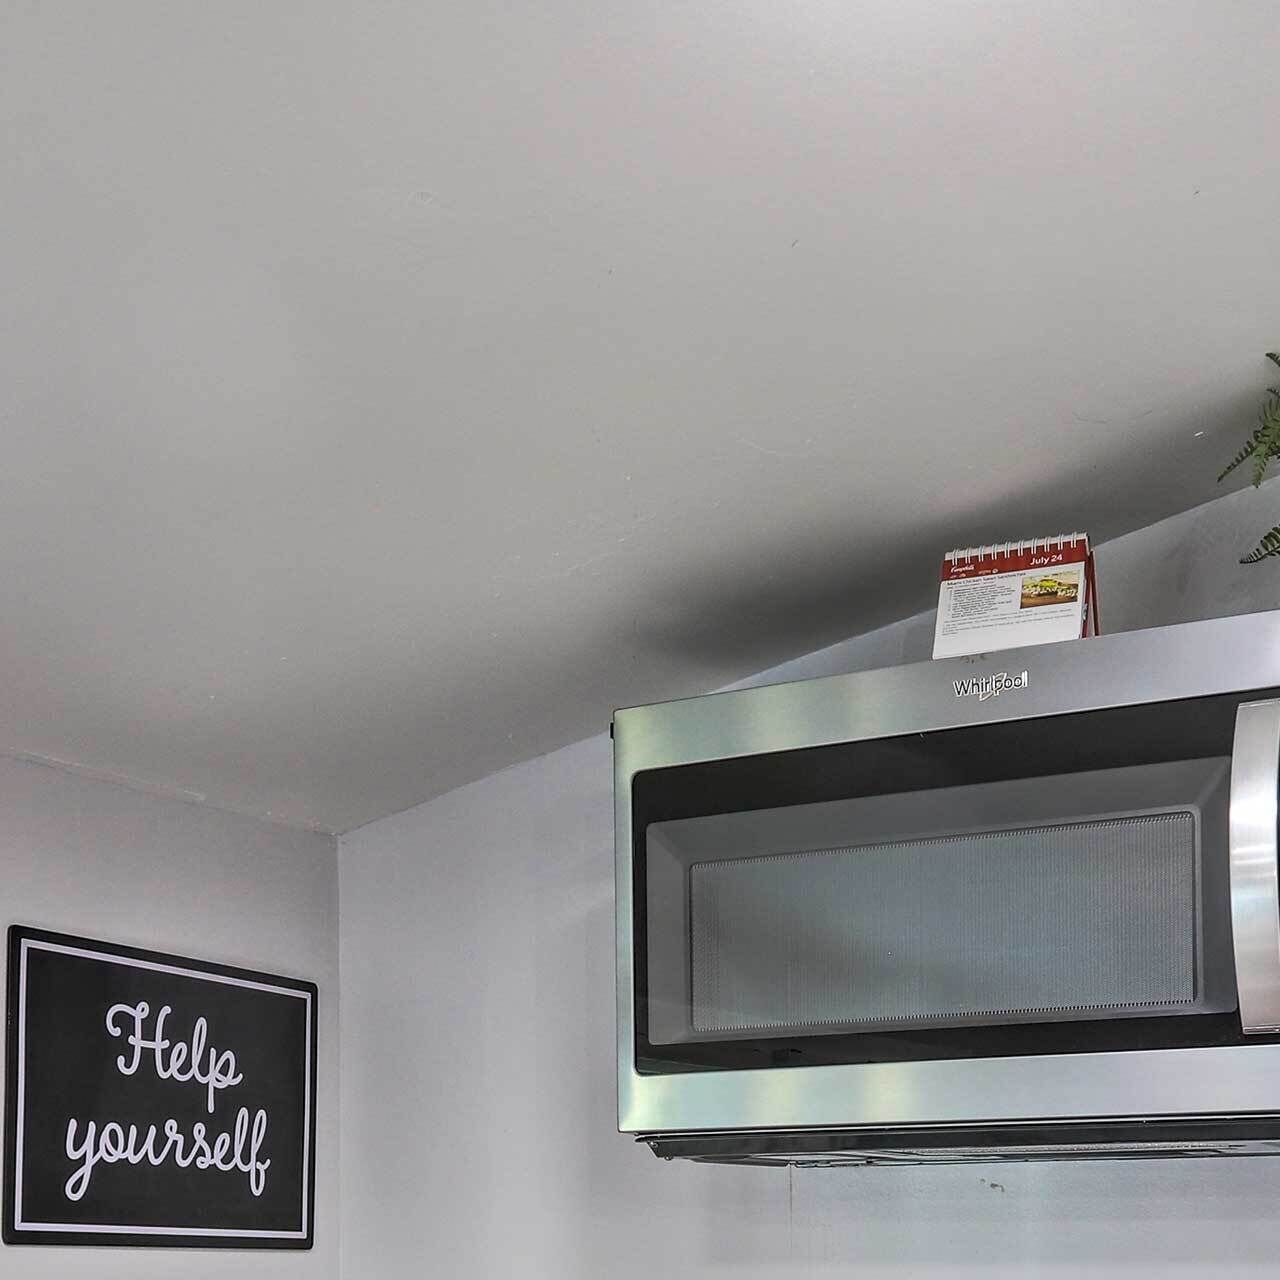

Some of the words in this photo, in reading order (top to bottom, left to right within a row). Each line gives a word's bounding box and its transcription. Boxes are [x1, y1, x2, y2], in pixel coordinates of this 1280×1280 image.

[1030, 556, 1050, 566] July
[1051, 554, 1063, 562] 24
[952, 670, 1028, 697] Whirlpool
[106, 1001, 243, 1113] Help
[65, 1107, 270, 1201] yourself
